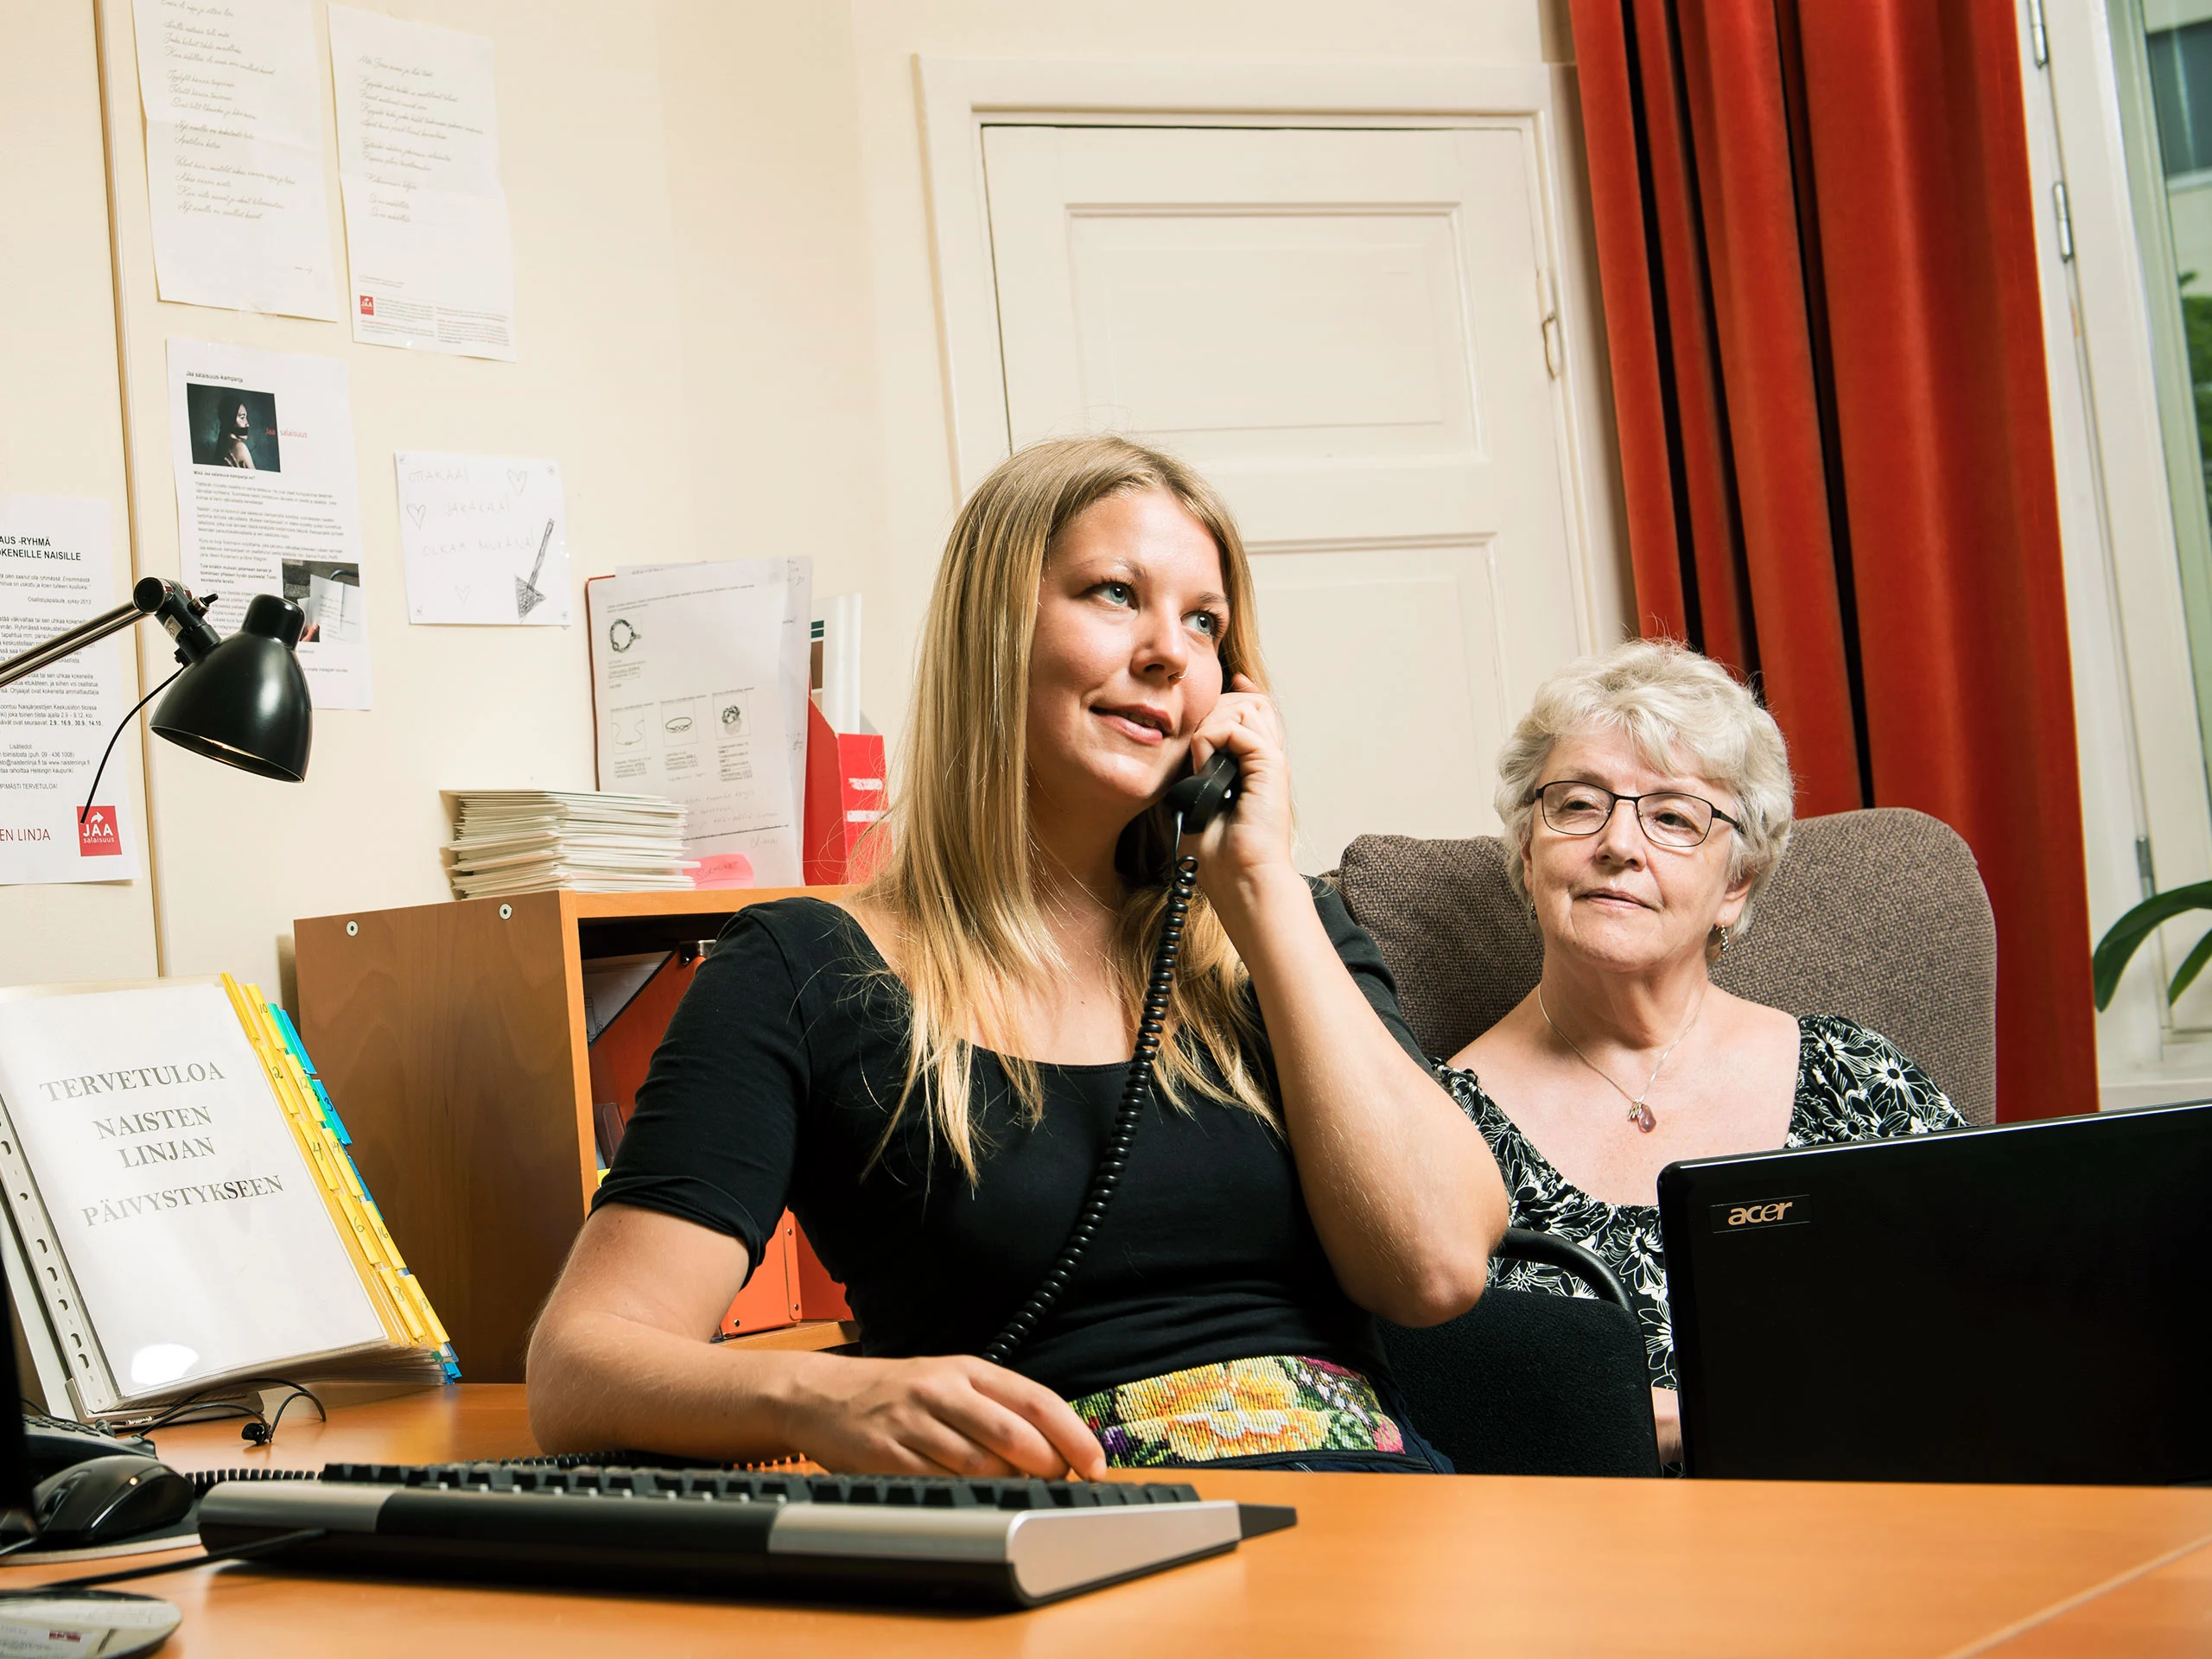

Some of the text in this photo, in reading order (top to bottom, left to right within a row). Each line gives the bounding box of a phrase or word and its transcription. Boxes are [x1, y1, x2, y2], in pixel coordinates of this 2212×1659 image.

[44, 550, 81, 561] NAISILLE
[17, 829, 51, 842] LINJA
[83, 823, 114, 836] JAA
[259, 1003, 269, 1014] 10
[272, 1066, 283, 1079] 2
[39, 1061, 226, 1103] TERVETULOA
[324, 1097, 334, 1112] 3
[92, 1106, 213, 1141] NAISTEN
[118, 1137, 216, 1168] LINJAN
[312, 1141, 324, 1161] 4
[81, 1174, 284, 1227] PÄIVYSTYKSEEN
[1727, 1202, 1793, 1226] acer
[353, 1216, 365, 1233] 6
[394, 1286, 404, 1303] 8
